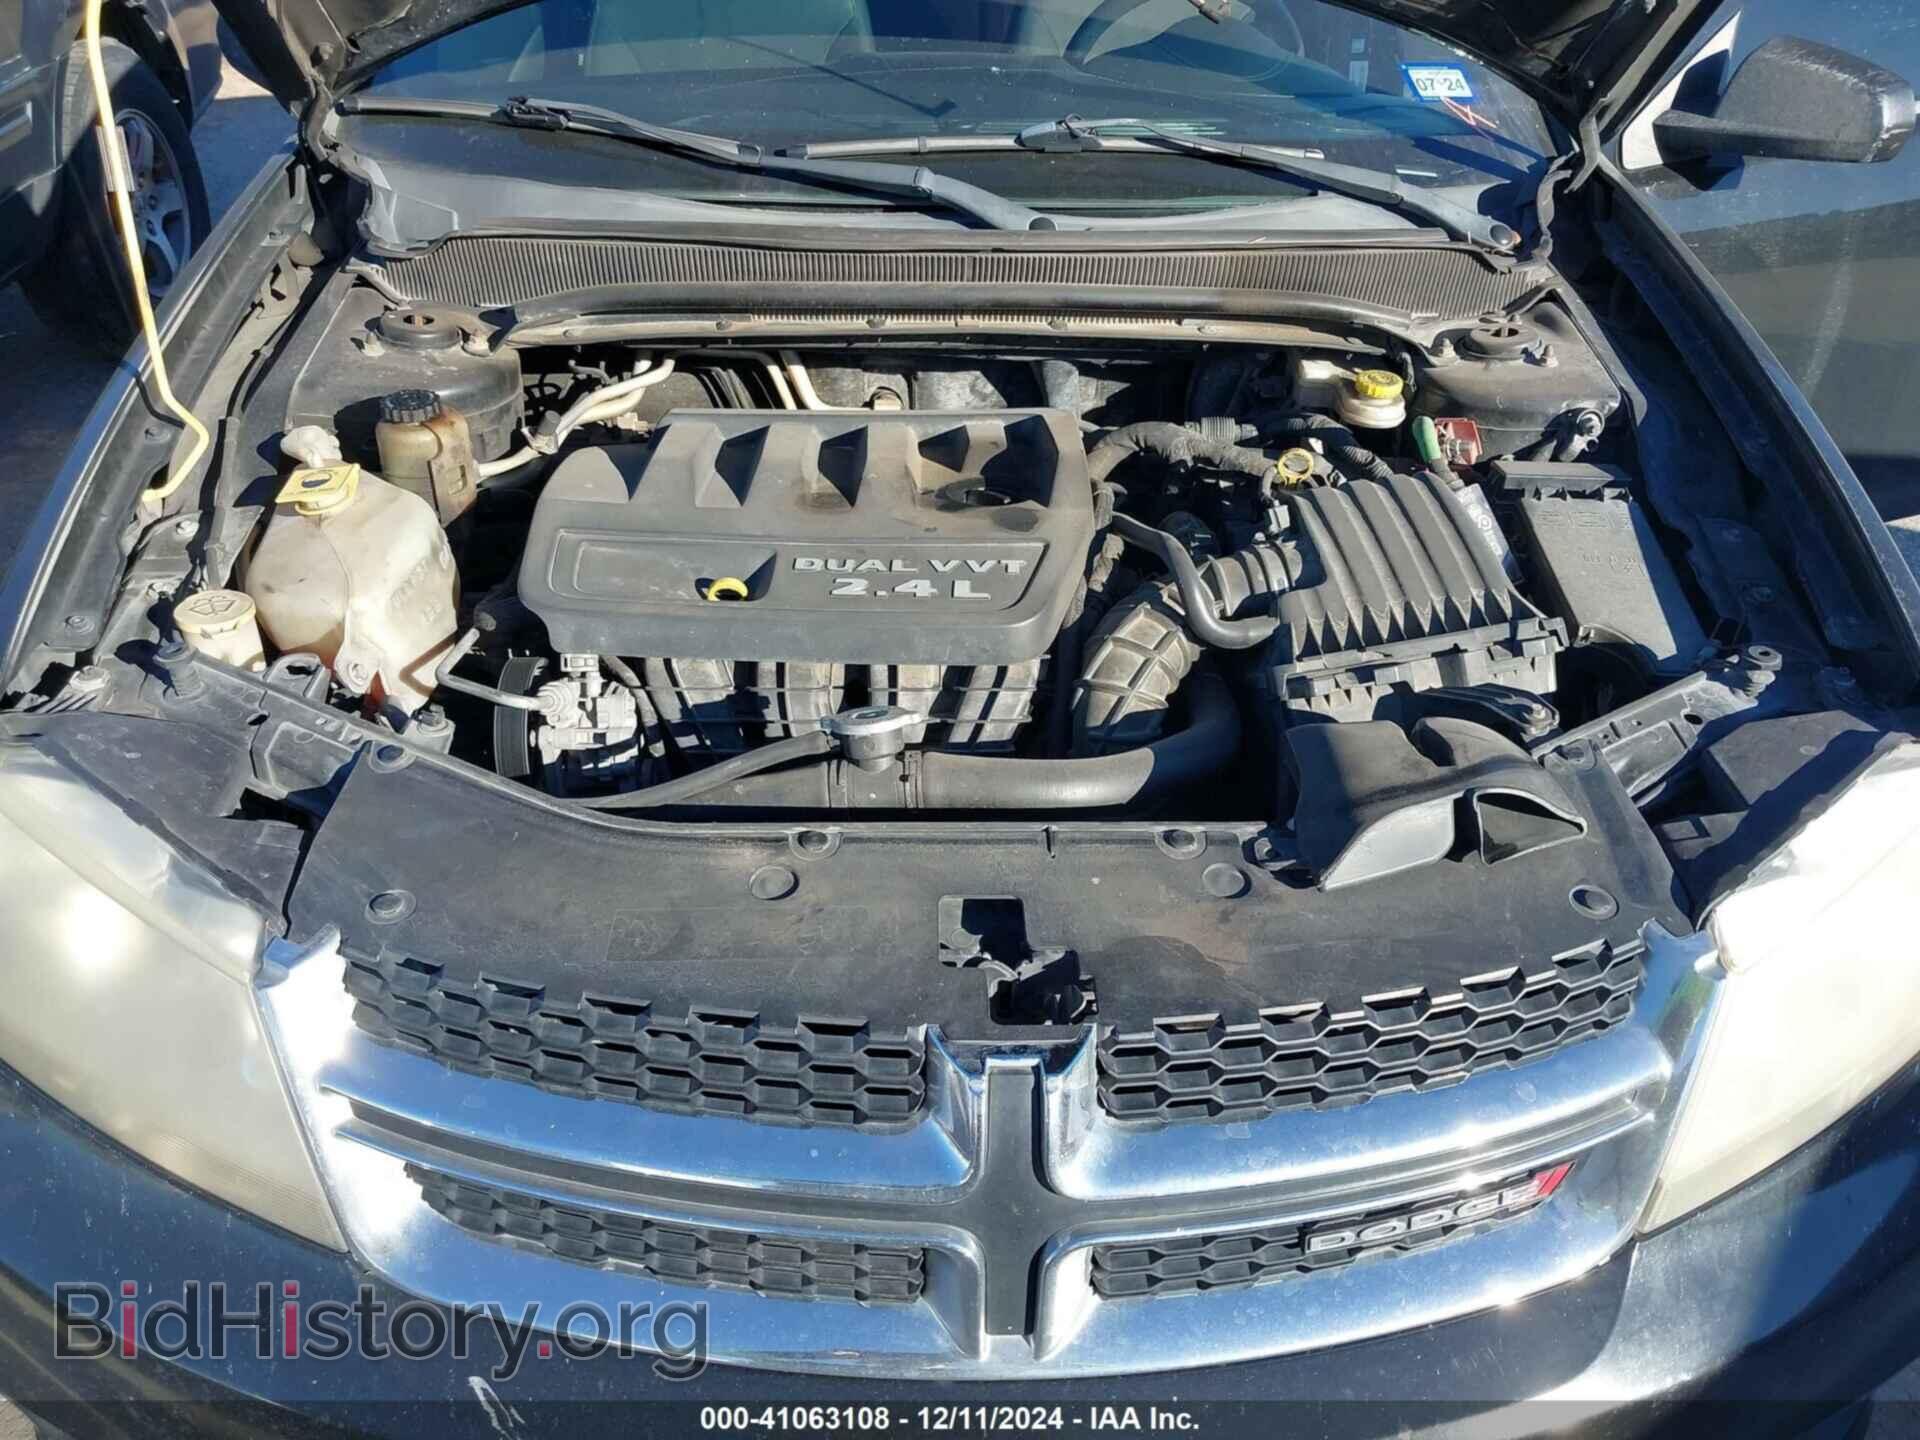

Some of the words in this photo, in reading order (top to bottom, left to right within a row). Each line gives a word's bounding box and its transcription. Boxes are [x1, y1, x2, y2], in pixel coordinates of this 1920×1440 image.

[1415, 77, 1435, 92] 07
[792, 557, 919, 574] DUAL
[928, 558, 1028, 574] VVT
[1303, 1179, 1543, 1253] DODGE
